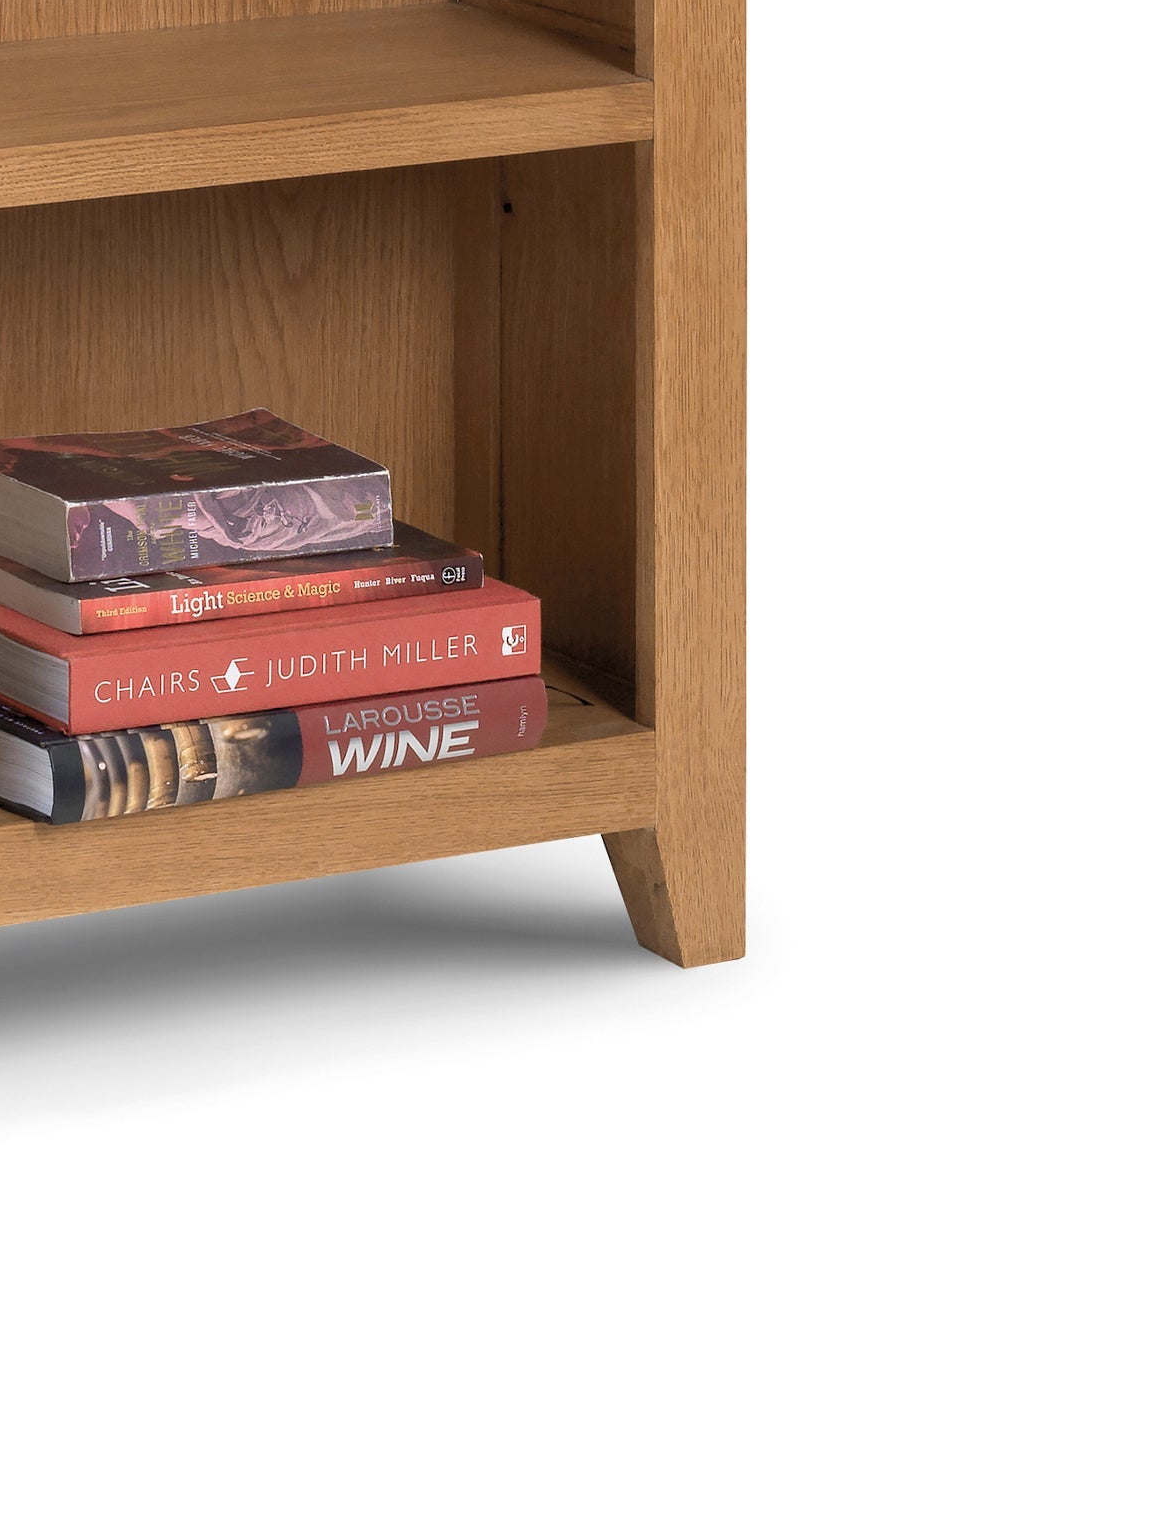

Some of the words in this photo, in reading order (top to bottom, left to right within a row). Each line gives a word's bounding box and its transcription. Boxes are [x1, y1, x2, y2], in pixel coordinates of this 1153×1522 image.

[158, 499, 186, 564] WHITE
[186, 501, 197, 527] FABER
[137, 530, 149, 567] CRIMSON
[188, 530, 199, 559] MICHEL
[170, 591, 224, 618] Light
[226, 588, 281, 606] Science
[284, 584, 295, 598] &
[297, 580, 341, 600] Magic
[353, 579, 381, 589] Hunter
[385, 576, 406, 585] Biver
[410, 573, 435, 583] Fuqua
[96, 608, 118, 618] Third
[119, 606, 147, 616] Edition
[265, 648, 367, 688] JUDITH
[382, 634, 479, 667] MILLER
[94, 669, 200, 704] CHAIRS
[323, 694, 481, 736] LAROUSSE
[517, 705, 527, 738] hamlyn
[326, 719, 480, 777] WINE
